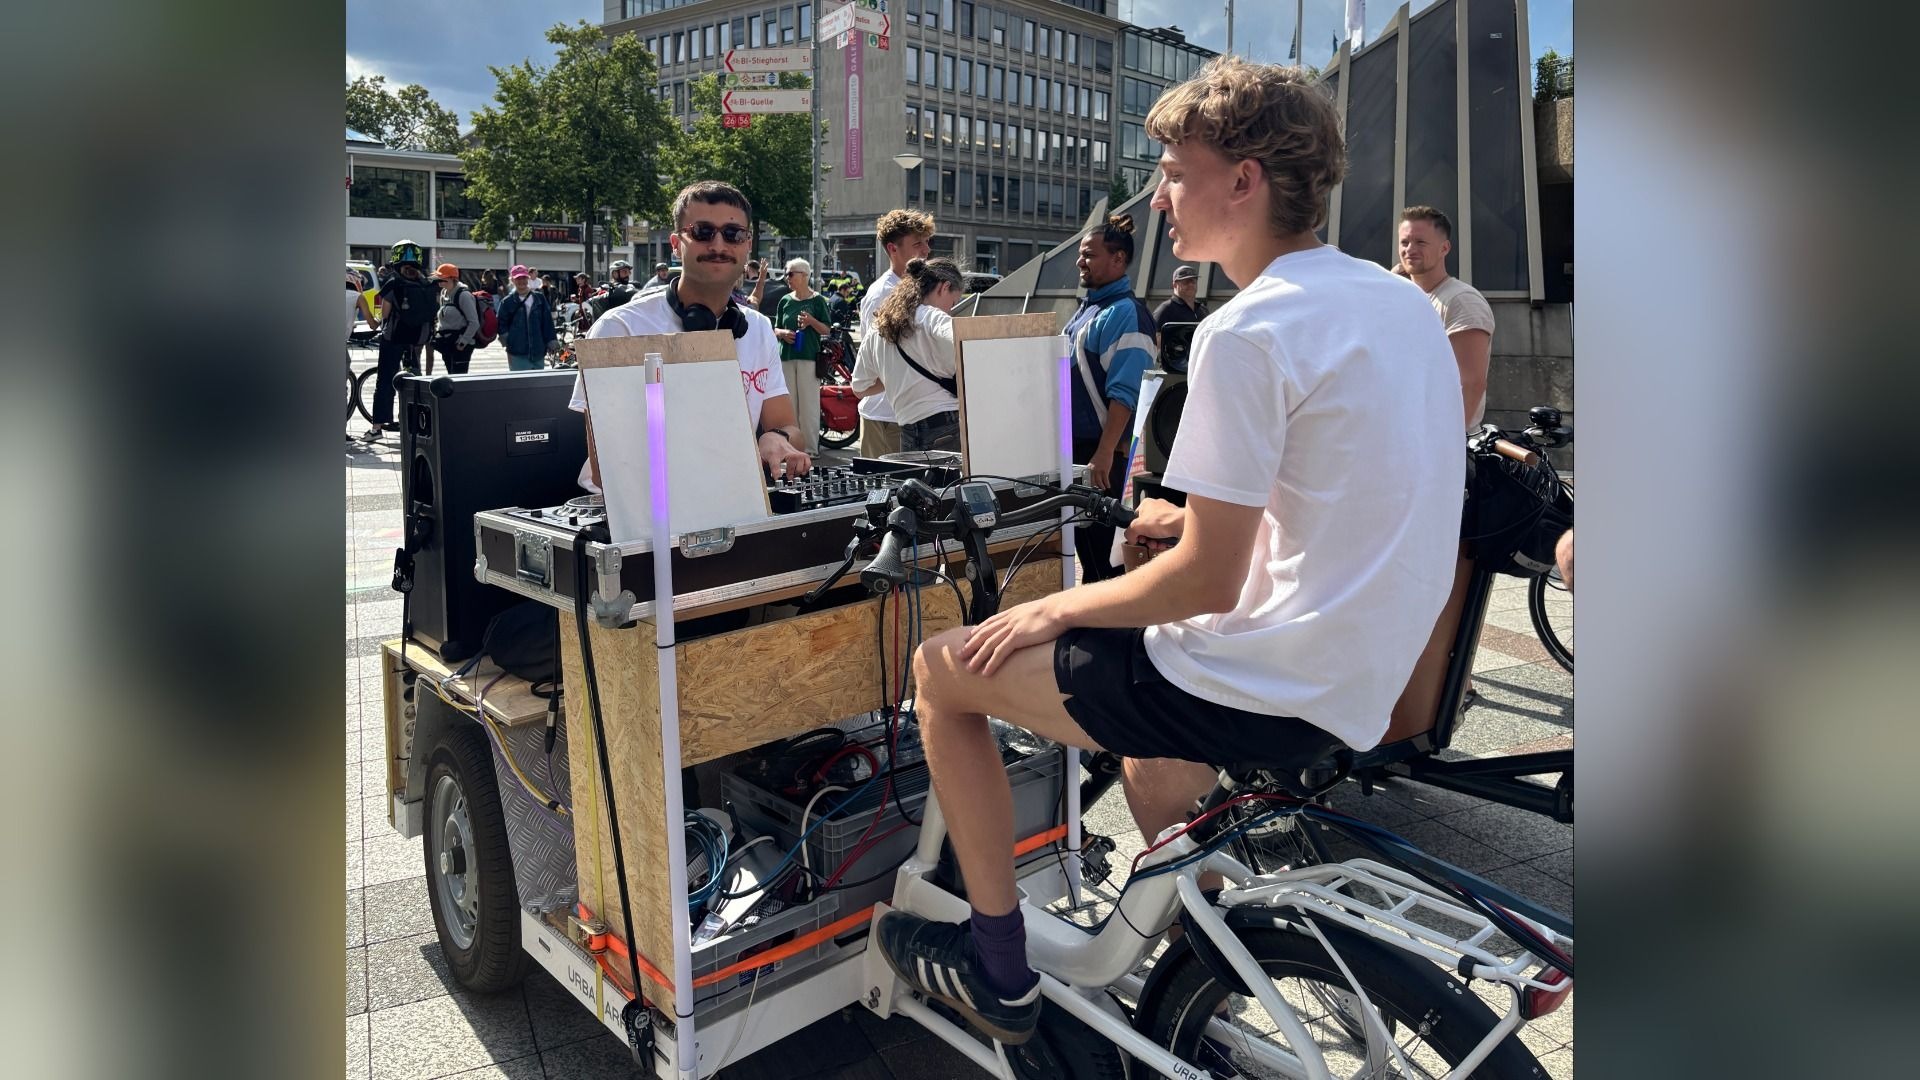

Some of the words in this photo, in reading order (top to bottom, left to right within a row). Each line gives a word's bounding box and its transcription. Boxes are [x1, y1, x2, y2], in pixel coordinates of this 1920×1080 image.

[740, 56, 788, 66] BI-Stieghorst
[739, 98, 774, 106] BI-Quelle
[567, 965, 597, 1003] URBA
